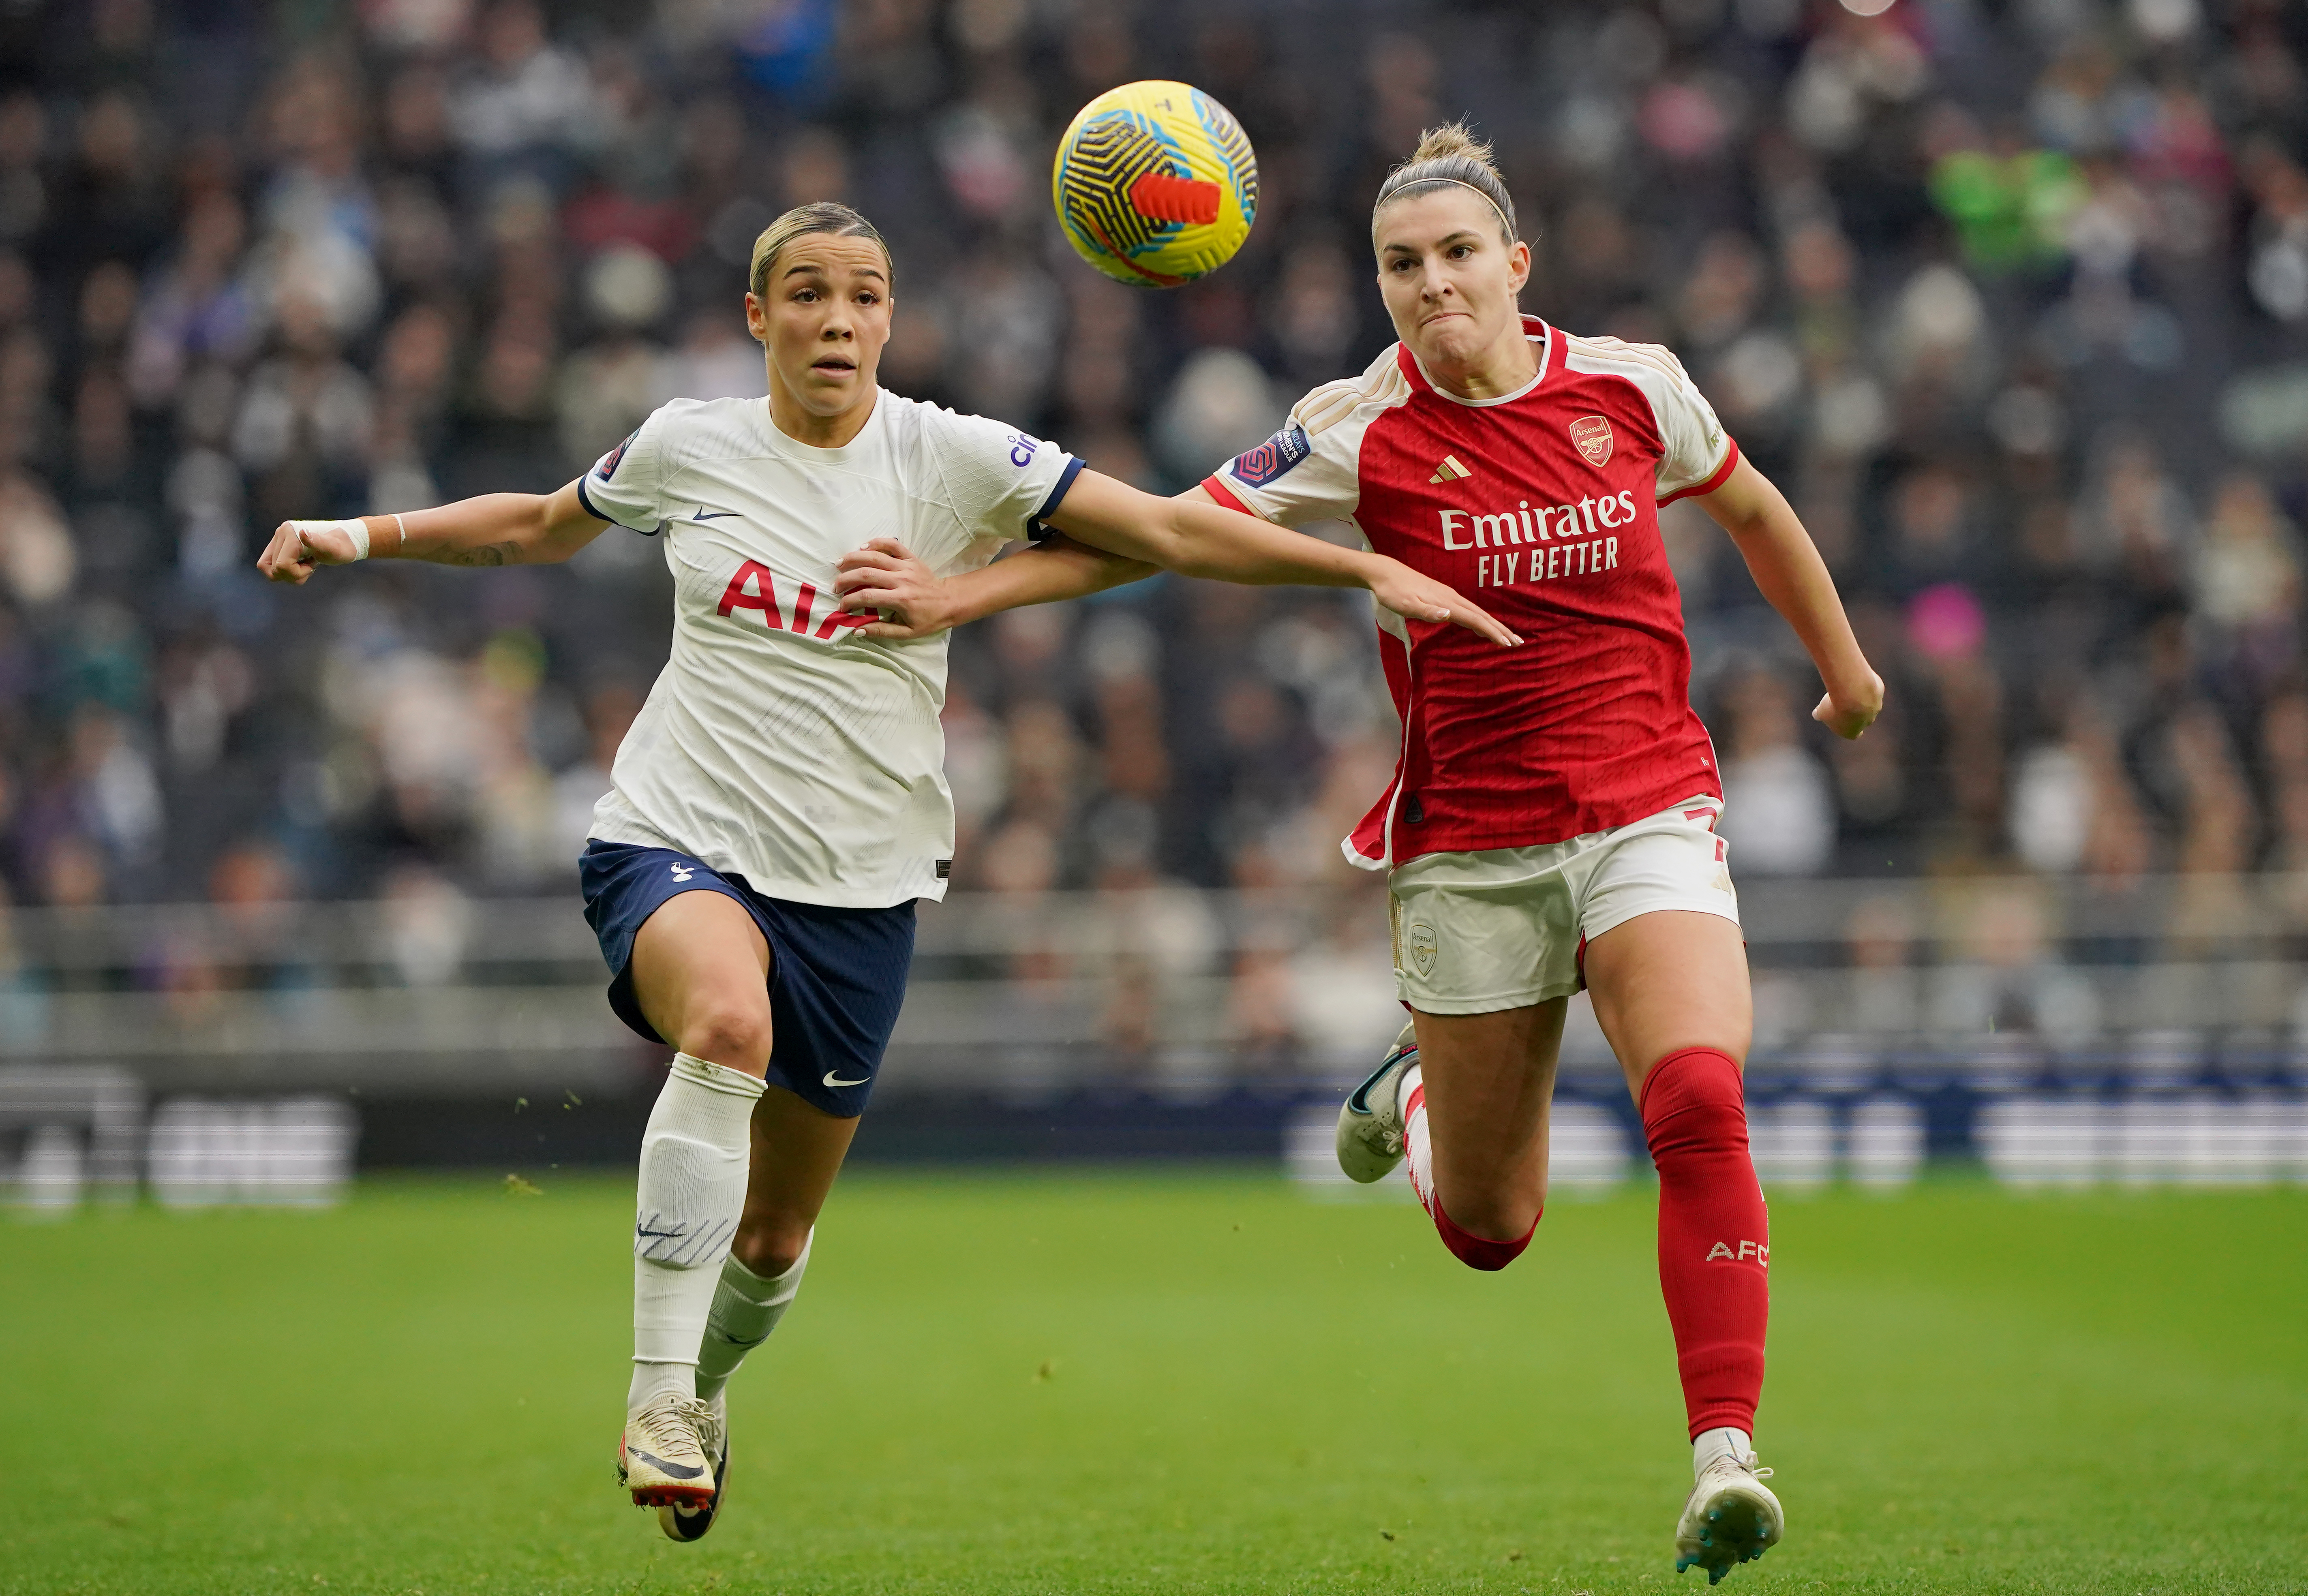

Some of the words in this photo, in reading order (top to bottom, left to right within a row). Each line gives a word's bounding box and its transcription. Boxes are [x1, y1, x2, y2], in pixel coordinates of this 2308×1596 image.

[1576, 424, 1604, 437] Arsenal
[1279, 441, 1293, 462] LEAGUE
[1438, 490, 1636, 550] Emirates
[1478, 552, 1520, 587] FLY
[1530, 536, 1618, 582] BETTER
[1413, 933, 1432, 943] Arsenal
[1706, 1240, 1767, 1268] AFC
